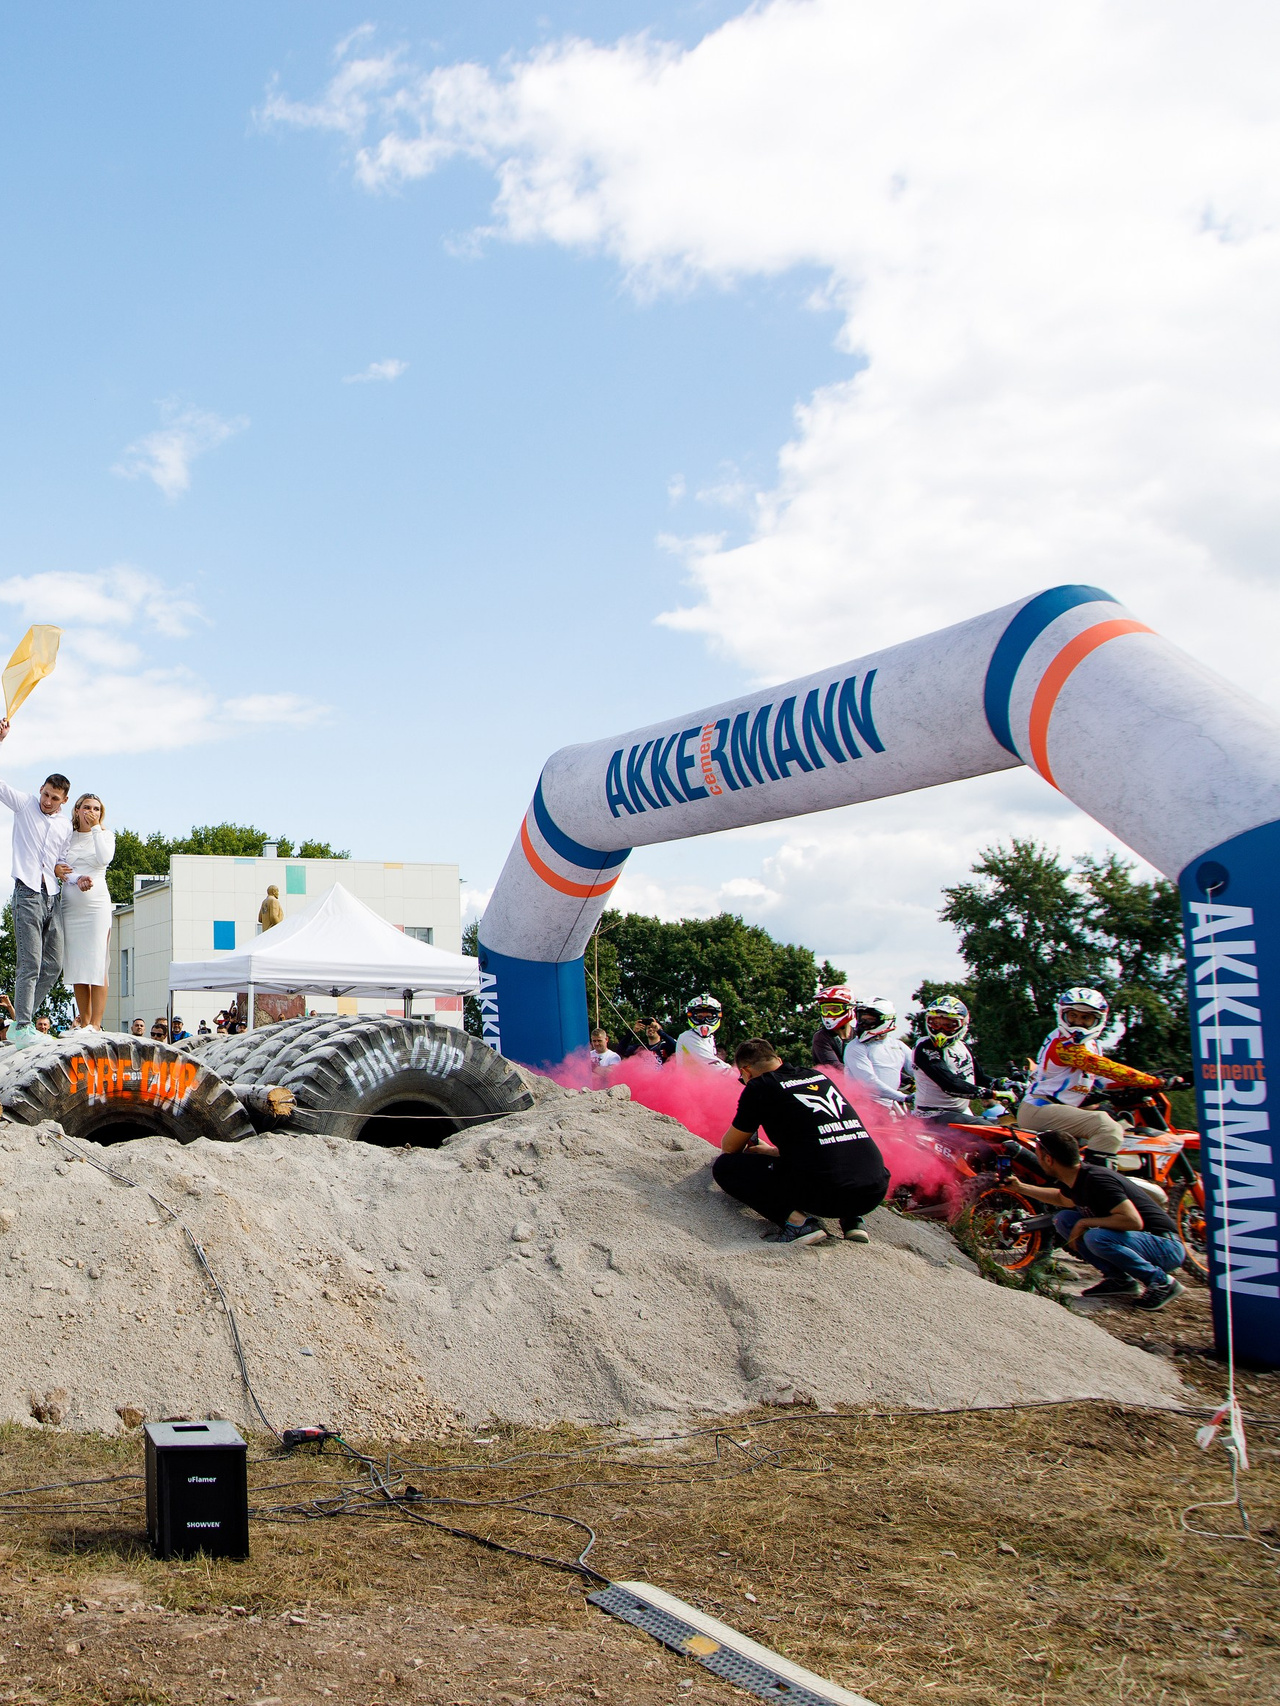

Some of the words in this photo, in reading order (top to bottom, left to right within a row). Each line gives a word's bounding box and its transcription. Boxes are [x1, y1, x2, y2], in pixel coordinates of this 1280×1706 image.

[606, 668, 887, 818] AKKERMANN
[700, 721, 724, 796] cement
[70, 1056, 133, 1099] FIRE
[140, 1059, 197, 1102] CUP
[410, 1036, 464, 1079] CUP
[1202, 1060, 1267, 1081] cement
[1189, 901, 1280, 1299] AKKERMANN
[817, 1121, 845, 1135] ROYAL
[818, 1135, 836, 1146] hard
[835, 1132, 857, 1143] enduro
